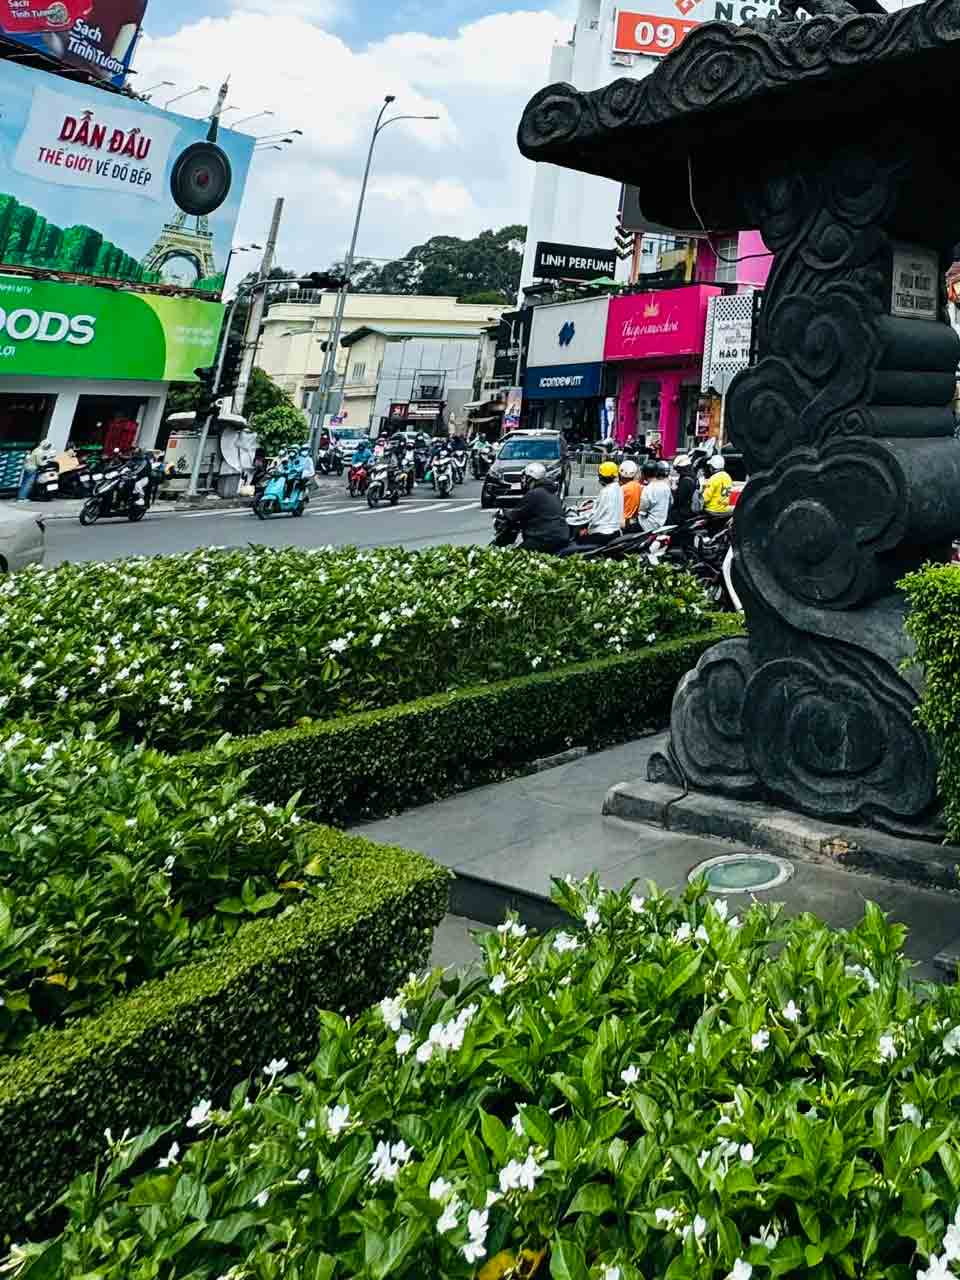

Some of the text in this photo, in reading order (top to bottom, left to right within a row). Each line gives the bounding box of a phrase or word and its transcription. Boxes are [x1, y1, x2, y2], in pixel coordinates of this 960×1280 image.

[73, 18, 102, 43] Sạch
[94, 48, 124, 74] Tươm
[129, 167, 151, 185] BẾP
[540, 253, 614, 272] LINH PERFUME
